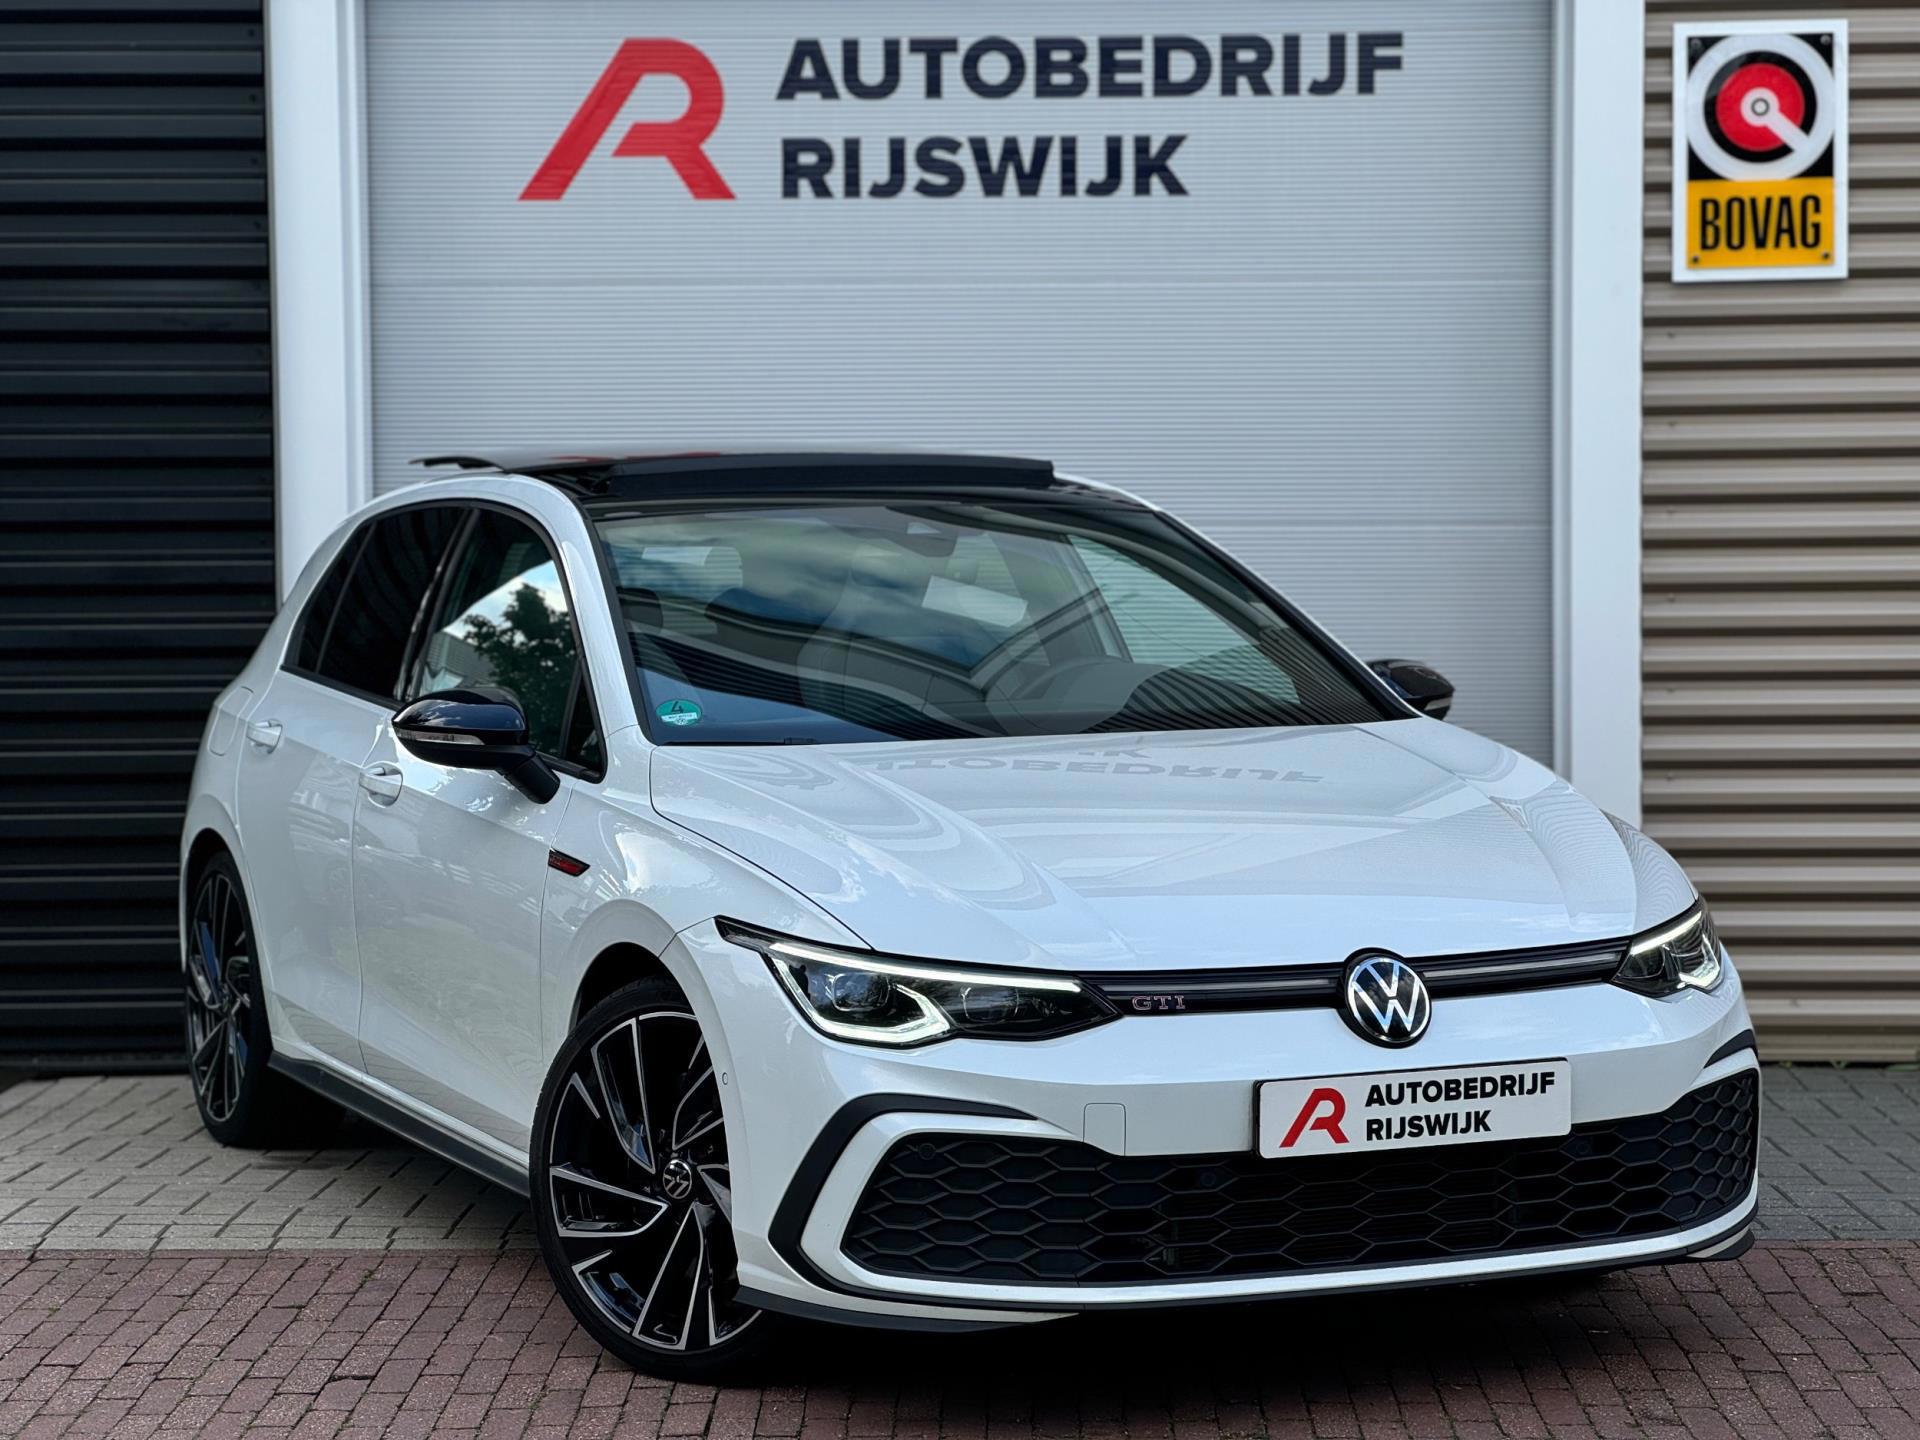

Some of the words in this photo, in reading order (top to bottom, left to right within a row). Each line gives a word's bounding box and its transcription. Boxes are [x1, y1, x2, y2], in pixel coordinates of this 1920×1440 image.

[775, 32, 1404, 99] AUTOBEDRIJF
[780, 134, 1189, 198] RIJSWIJK
[1700, 195, 1822, 250] BOVAG
[1132, 995, 1186, 1011] GTI
[1365, 1072, 1555, 1107] AUTOBEDRIJF
[1366, 1110, 1491, 1141] RIJSWIJK
